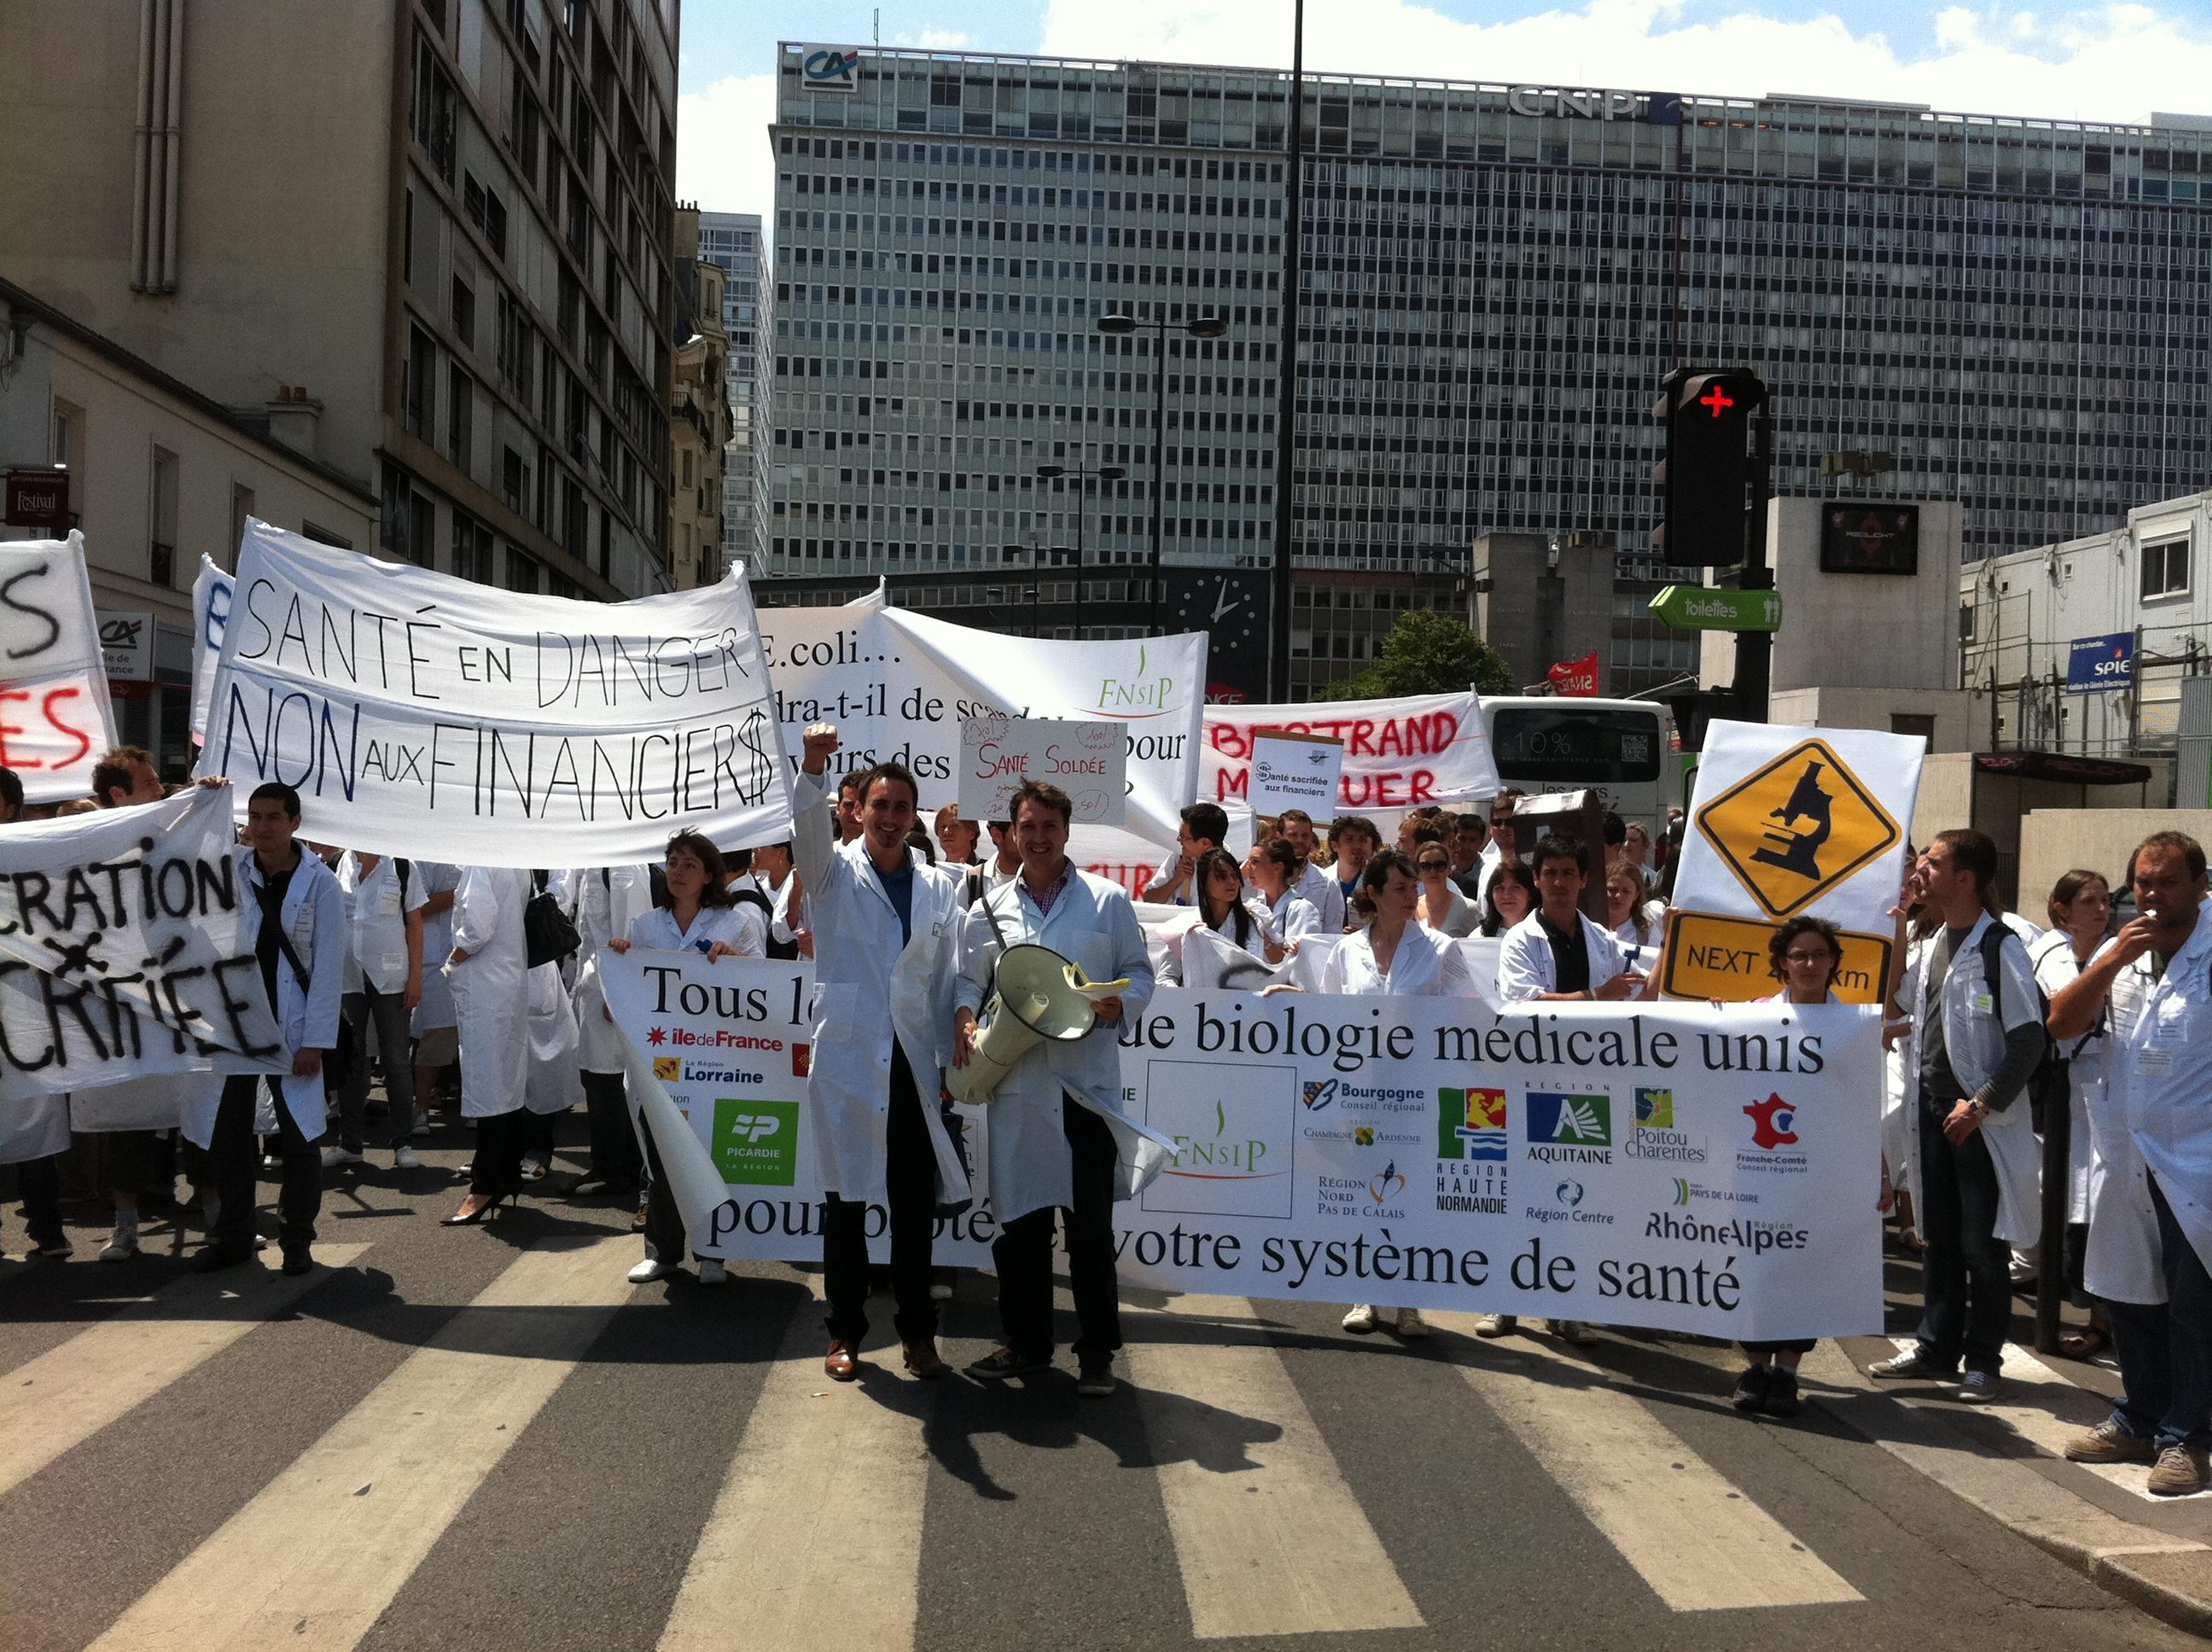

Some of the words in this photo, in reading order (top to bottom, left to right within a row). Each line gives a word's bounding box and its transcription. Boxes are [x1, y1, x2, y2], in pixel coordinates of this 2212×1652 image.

[1509, 84, 1638, 121] CNP
[17, 491, 55, 511] Festival
[239, 579, 441, 700] SANTÉ
[458, 646, 512, 683] EN
[537, 626, 749, 708] DANGER
[106, 666, 135, 675] rance
[2094, 659, 2131, 677] SPIE
[900, 687, 945, 723] de
[222, 683, 360, 801] NON
[361, 739, 425, 786] AUX
[975, 742, 1029, 779] SANTÉ
[1265, 784, 1281, 793] aux
[1282, 784, 1326, 797] financiers
[1290, 776, 1329, 786] sacrifiée
[1686, 944, 1761, 975] NEXT
[643, 966, 767, 1023] Tous
[1194, 1002, 1414, 1073] biologie
[1433, 1013, 1679, 1068] médicale
[1697, 1017, 1825, 1074] unis
[684, 1067, 765, 1084] Lorraine
[1341, 1082, 1425, 1102] Bourgogne
[1341, 1100, 1377, 1110] Conseil
[1382, 1102, 1425, 1113] régional
[1636, 1127, 1688, 1146] Poitou
[726, 1147, 782, 1159] PICARDIE
[1527, 1147, 1613, 1166] AQUITAINE
[1625, 1140, 1705, 1162] Charentes
[1736, 1153, 1807, 1165] Franche-Comté
[1736, 1163, 1767, 1172] Conseil
[1769, 1164, 1807, 1174] régional
[1318, 1189, 1354, 1202] NORD
[1436, 1177, 1508, 1196] HAUTE
[1436, 1195, 1508, 1215] NORMANDIE
[1690, 1189, 1710, 1200] PAYS
[1711, 1190, 1723, 1201] DE
[1724, 1192, 1735, 1202] LA
[1735, 1193, 1760, 1204] LOIRE
[1526, 1207, 1569, 1222] Région
[1572, 1210, 1615, 1224] Centre
[1261, 1228, 1489, 1289] système
[1510, 1237, 1576, 1294] de
[1598, 1257, 1740, 1312] santé
